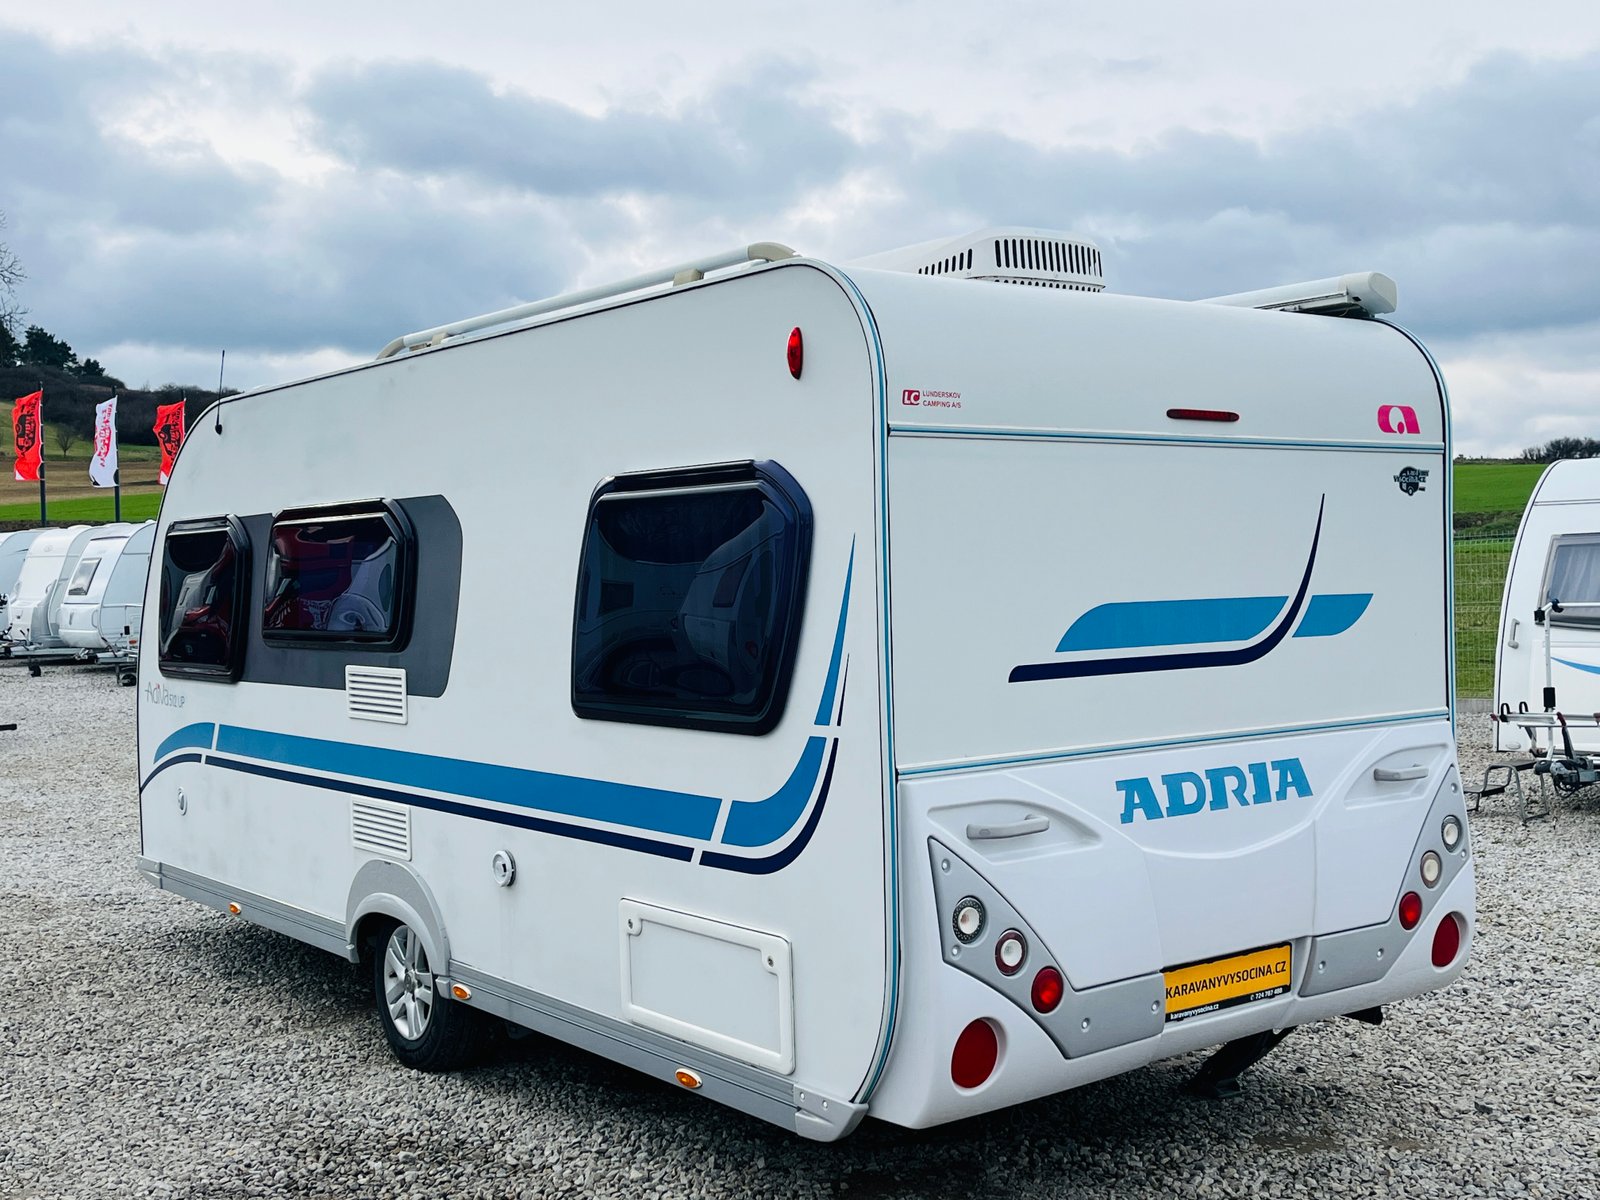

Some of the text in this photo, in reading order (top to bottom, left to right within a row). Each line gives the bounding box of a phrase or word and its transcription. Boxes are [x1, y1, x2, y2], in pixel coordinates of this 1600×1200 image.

[922, 390, 961, 399] LUNDERSKOV
[922, 400, 962, 409] CAMPING A/S
[1115, 757, 1314, 824] ADRIA
[1165, 960, 1287, 1000] KARAVANYVYSOCINA.CZ
[1170, 1003, 1220, 1020] karavanyvysocina.cz
